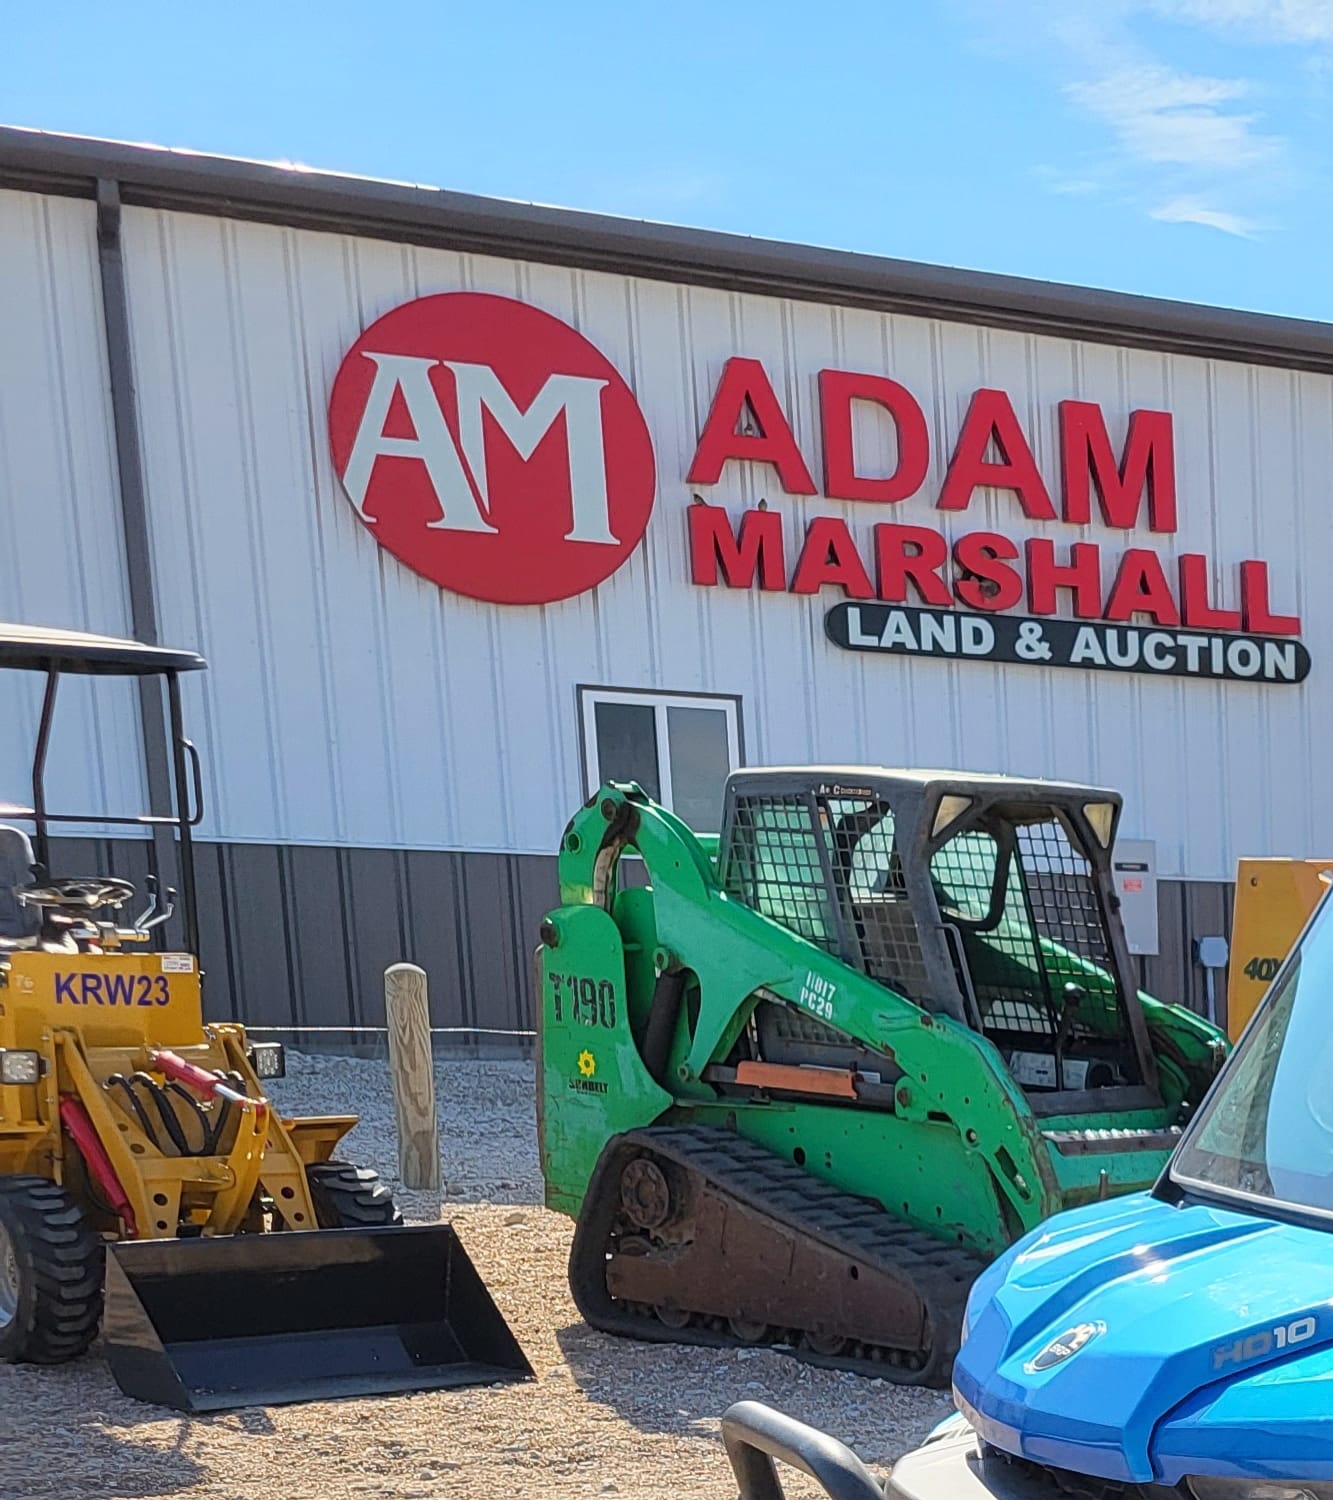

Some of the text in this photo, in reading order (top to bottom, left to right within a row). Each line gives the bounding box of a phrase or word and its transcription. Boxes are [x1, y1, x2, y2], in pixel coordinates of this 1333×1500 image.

[343, 351, 621, 546] AM
[686, 356, 1177, 533] ADAM
[687, 504, 1301, 637] MARSHALL
[846, 606, 1297, 681] LAND & AUCTION
[54, 972, 171, 1007] KRW23
[548, 971, 617, 1029] T190
[800, 986, 833, 1021] PC29
[1213, 1316, 1317, 1369] HD10
